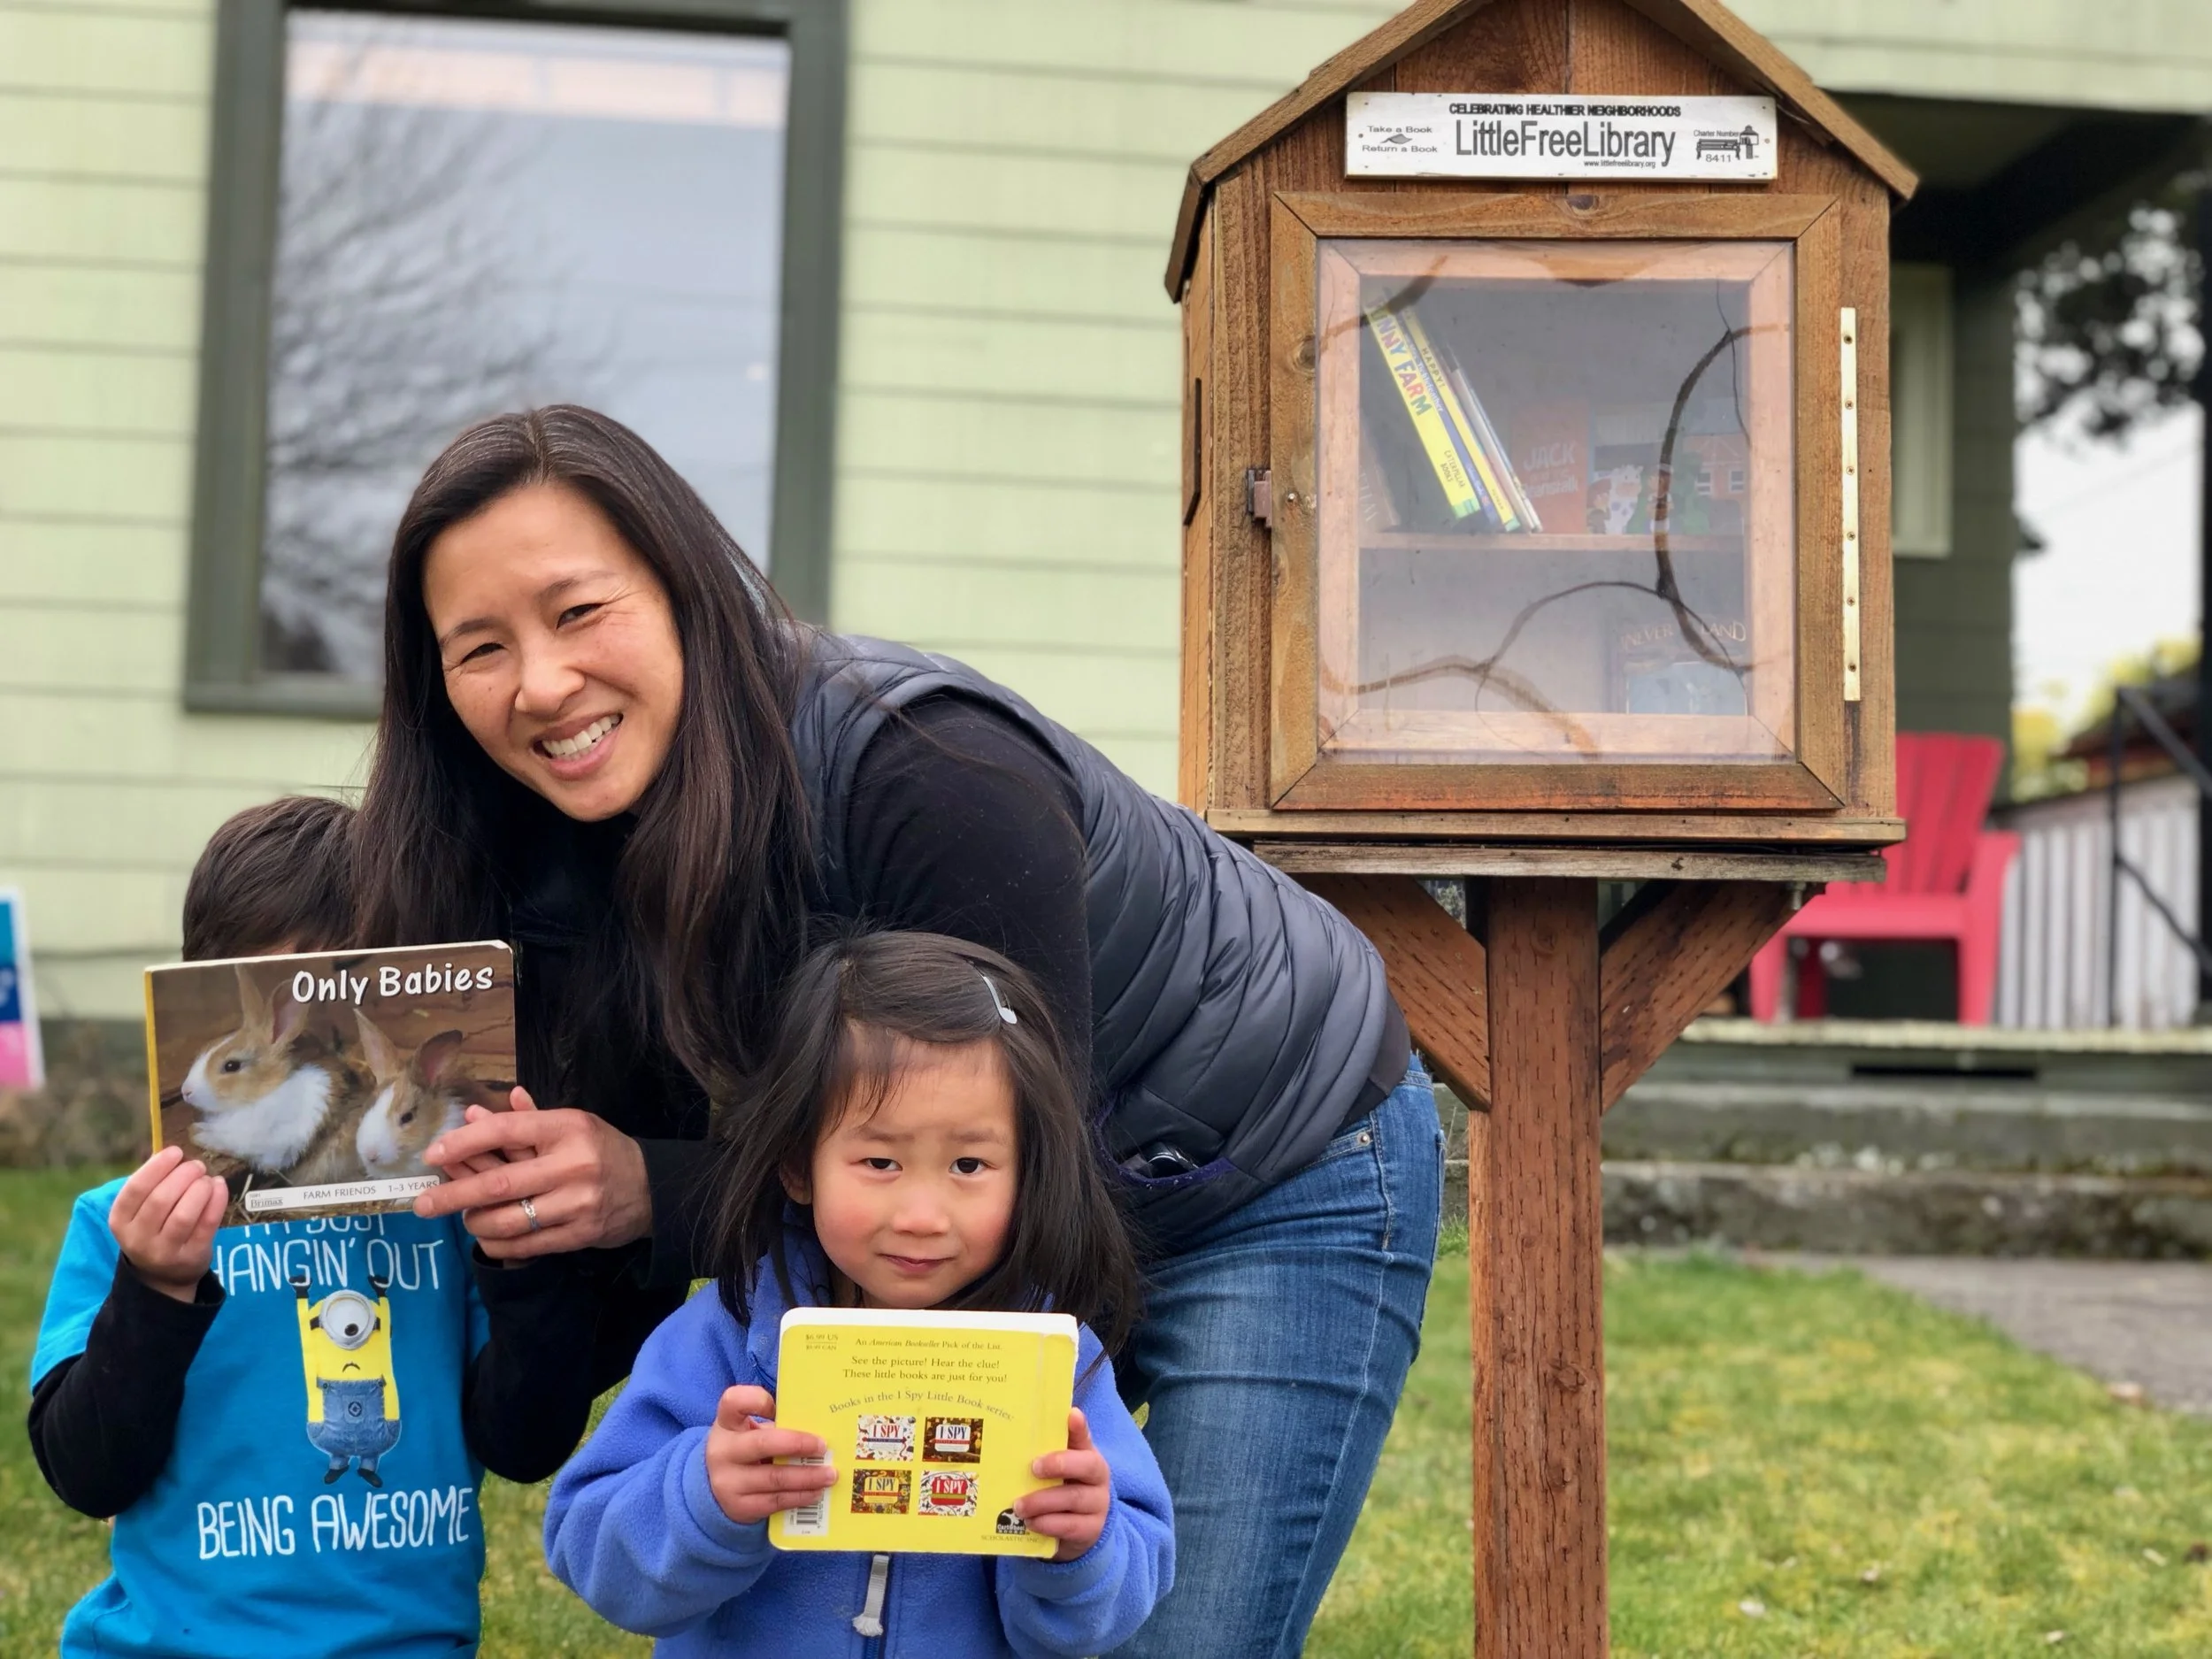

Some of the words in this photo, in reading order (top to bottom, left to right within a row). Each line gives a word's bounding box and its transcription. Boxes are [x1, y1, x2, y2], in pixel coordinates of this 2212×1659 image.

[1448, 103, 1524, 115] CELEBRATING
[1526, 104, 1585, 116] HEALTHIER
[1587, 104, 1681, 117] NEIGHBORHOODS
[1455, 120, 1676, 166] LittleFreeLibrary
[1706, 154, 1732, 163] 8411
[1422, 347, 1445, 388] HAPPY!
[1394, 360, 1432, 416] FARM
[1524, 441, 1576, 471] JACK
[292, 971, 369, 1005] Only
[380, 964, 494, 997] Babies
[303, 1190, 331, 1200] FARM
[334, 1186, 376, 1197] FRIENDS
[408, 1180, 438, 1191] YEARS
[250, 1197, 283, 1209] Brimax
[367, 1239, 444, 1291] OUT
[851, 1356, 869, 1364] See
[872, 1356, 887, 1365] the
[890, 1356, 927, 1368] picture!
[932, 1358, 955, 1367] Hear
[958, 1359, 973, 1368] the
[977, 1360, 1000, 1369] clue!
[843, 1369, 872, 1379] These
[874, 1370, 896, 1379] little
[899, 1371, 928, 1379] books
[947, 1371, 965, 1383] just
[969, 1372, 983, 1382] for
[985, 1373, 1008, 1385] you!
[829, 1398, 861, 1413] Books
[878, 1392, 894, 1401] the
[905, 1390, 924, 1402] Spy
[927, 1390, 954, 1402] Little
[956, 1394, 983, 1408] Book
[880, 1425, 901, 1438] SPY
[947, 1426, 967, 1440] SPY
[876, 1478, 895, 1492] SPY
[943, 1480, 964, 1494] SPY
[197, 1494, 296, 1559] BEING
[311, 1485, 473, 1553] AWESOME
